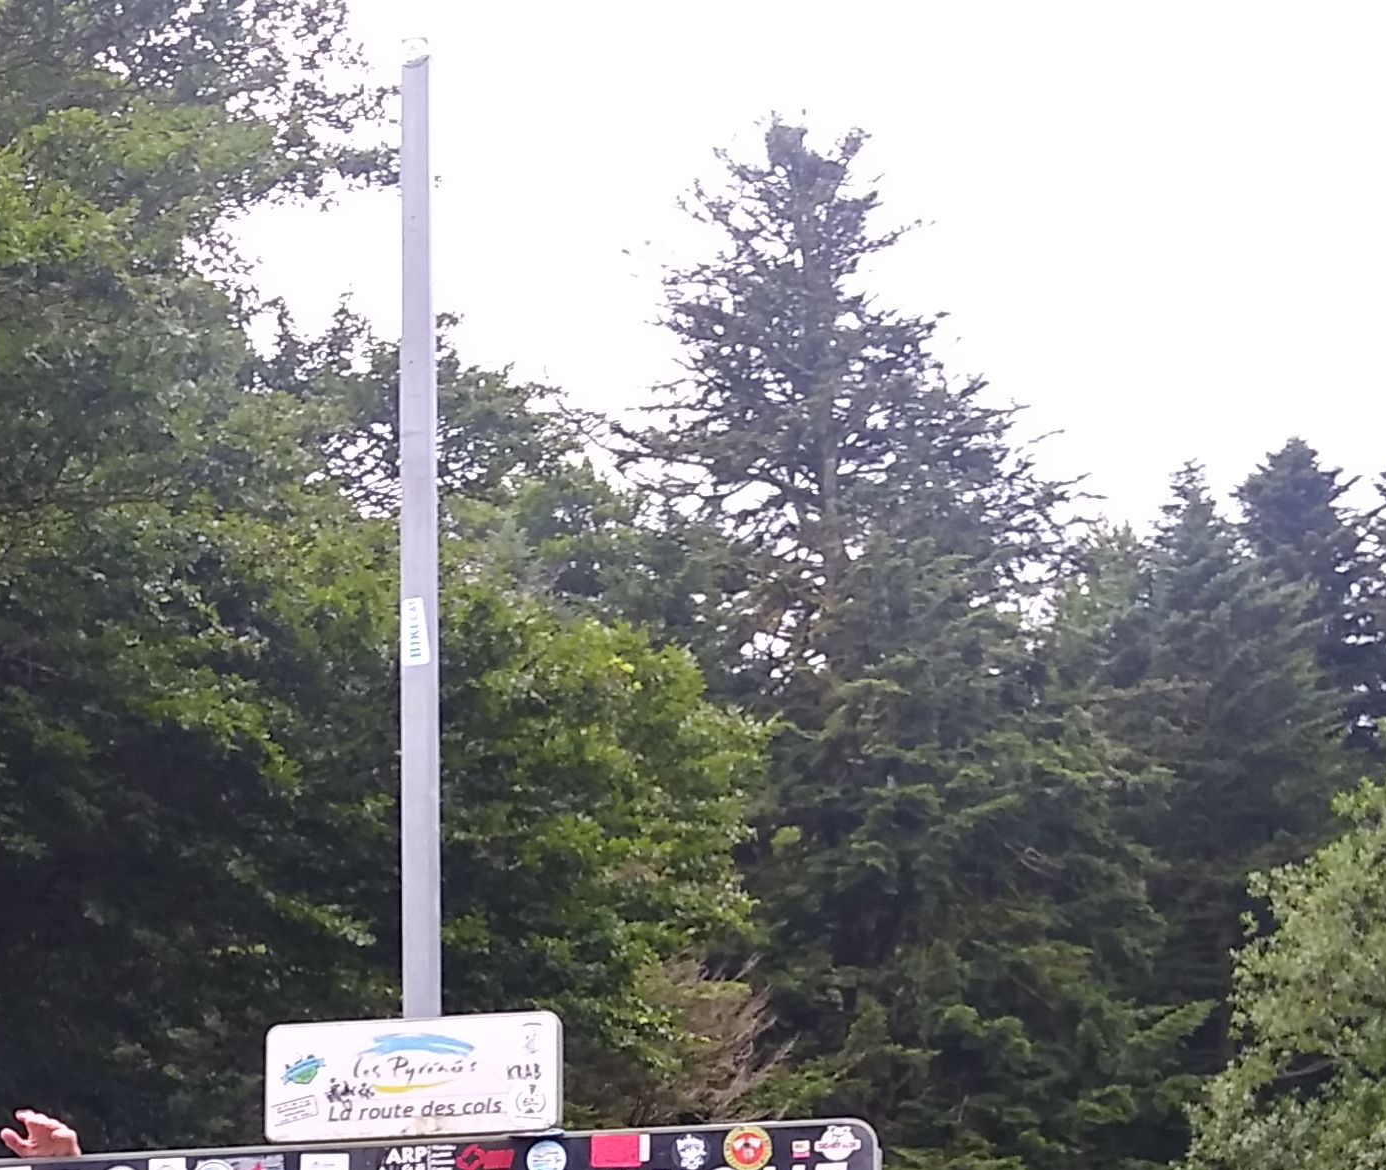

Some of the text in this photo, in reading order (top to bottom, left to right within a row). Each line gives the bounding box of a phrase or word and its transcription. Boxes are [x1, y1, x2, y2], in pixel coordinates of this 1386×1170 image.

[328, 1105, 351, 1122] La
[358, 1101, 412, 1120] route
[420, 1099, 455, 1117] des
[462, 1096, 503, 1115] cols
